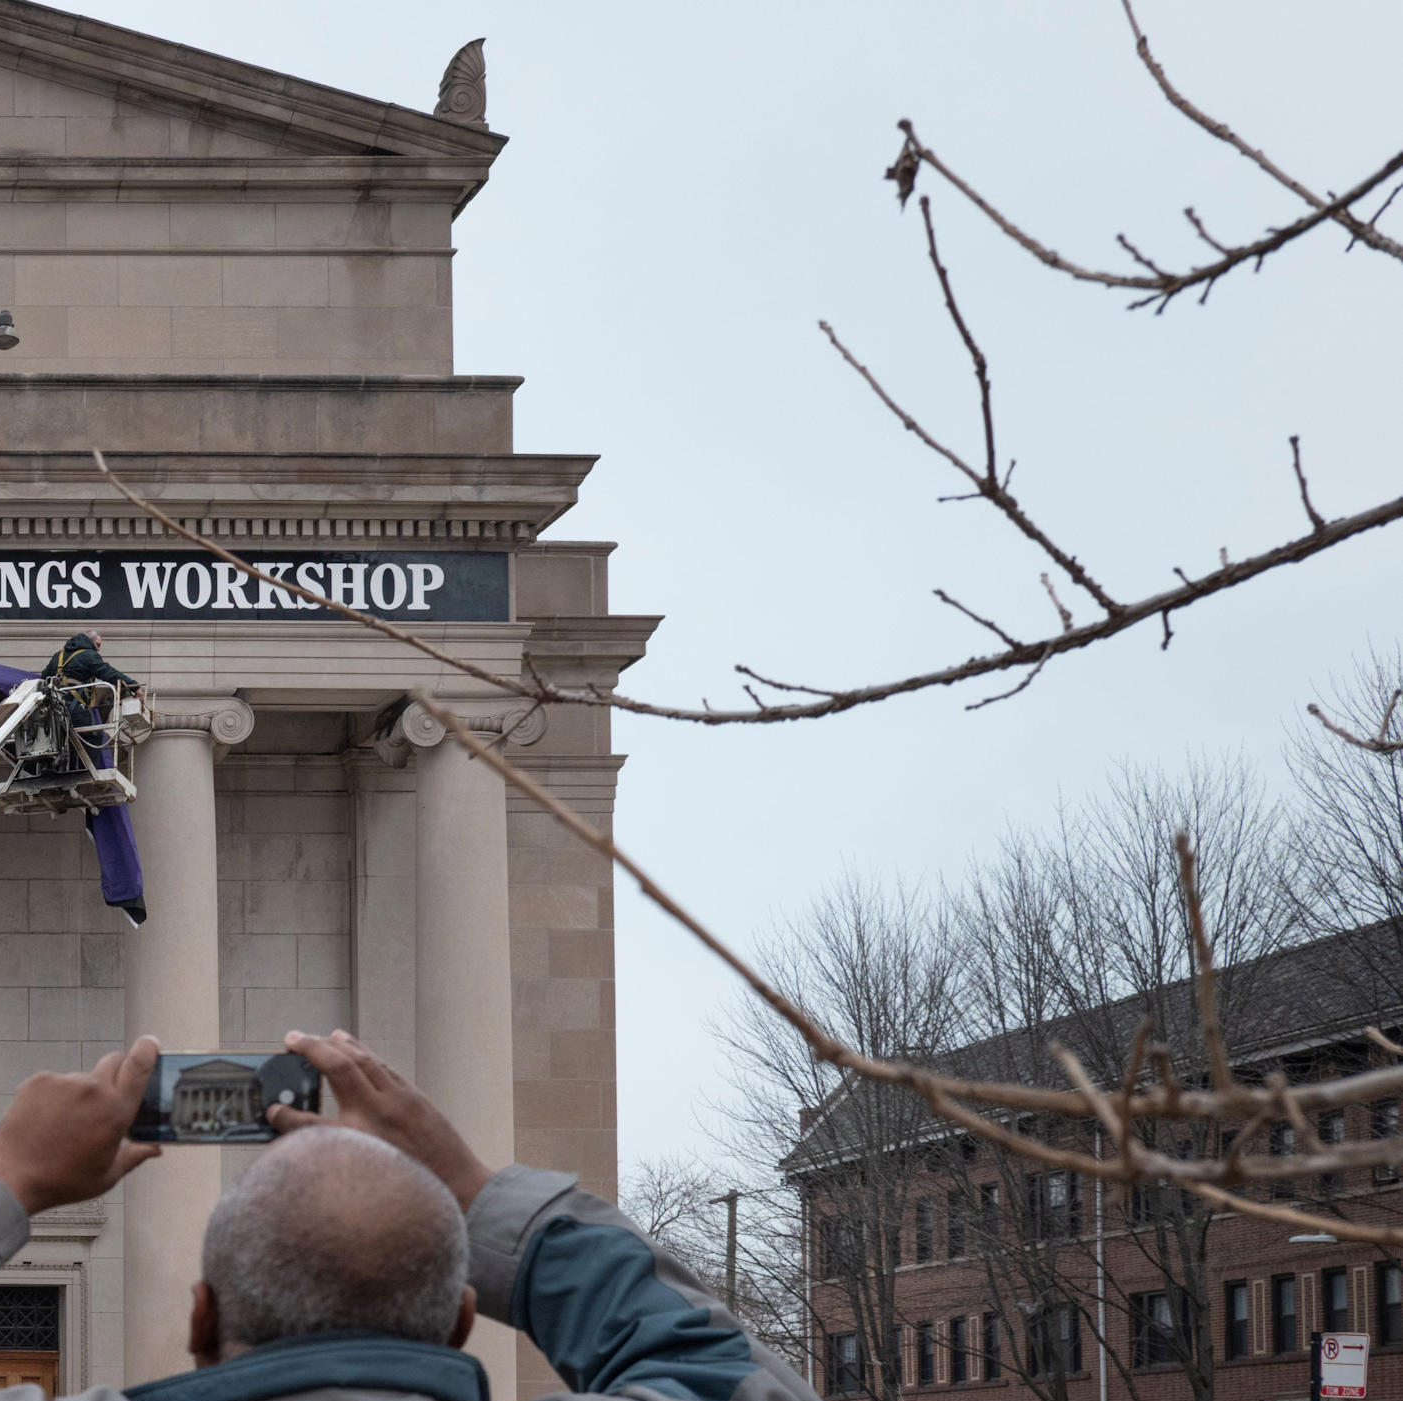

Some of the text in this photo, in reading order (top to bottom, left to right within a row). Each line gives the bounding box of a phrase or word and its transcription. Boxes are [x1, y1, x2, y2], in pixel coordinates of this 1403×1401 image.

[120, 562, 445, 611] WORKSHOP
[1325, 1386, 1360, 1396] TOW ZONE
